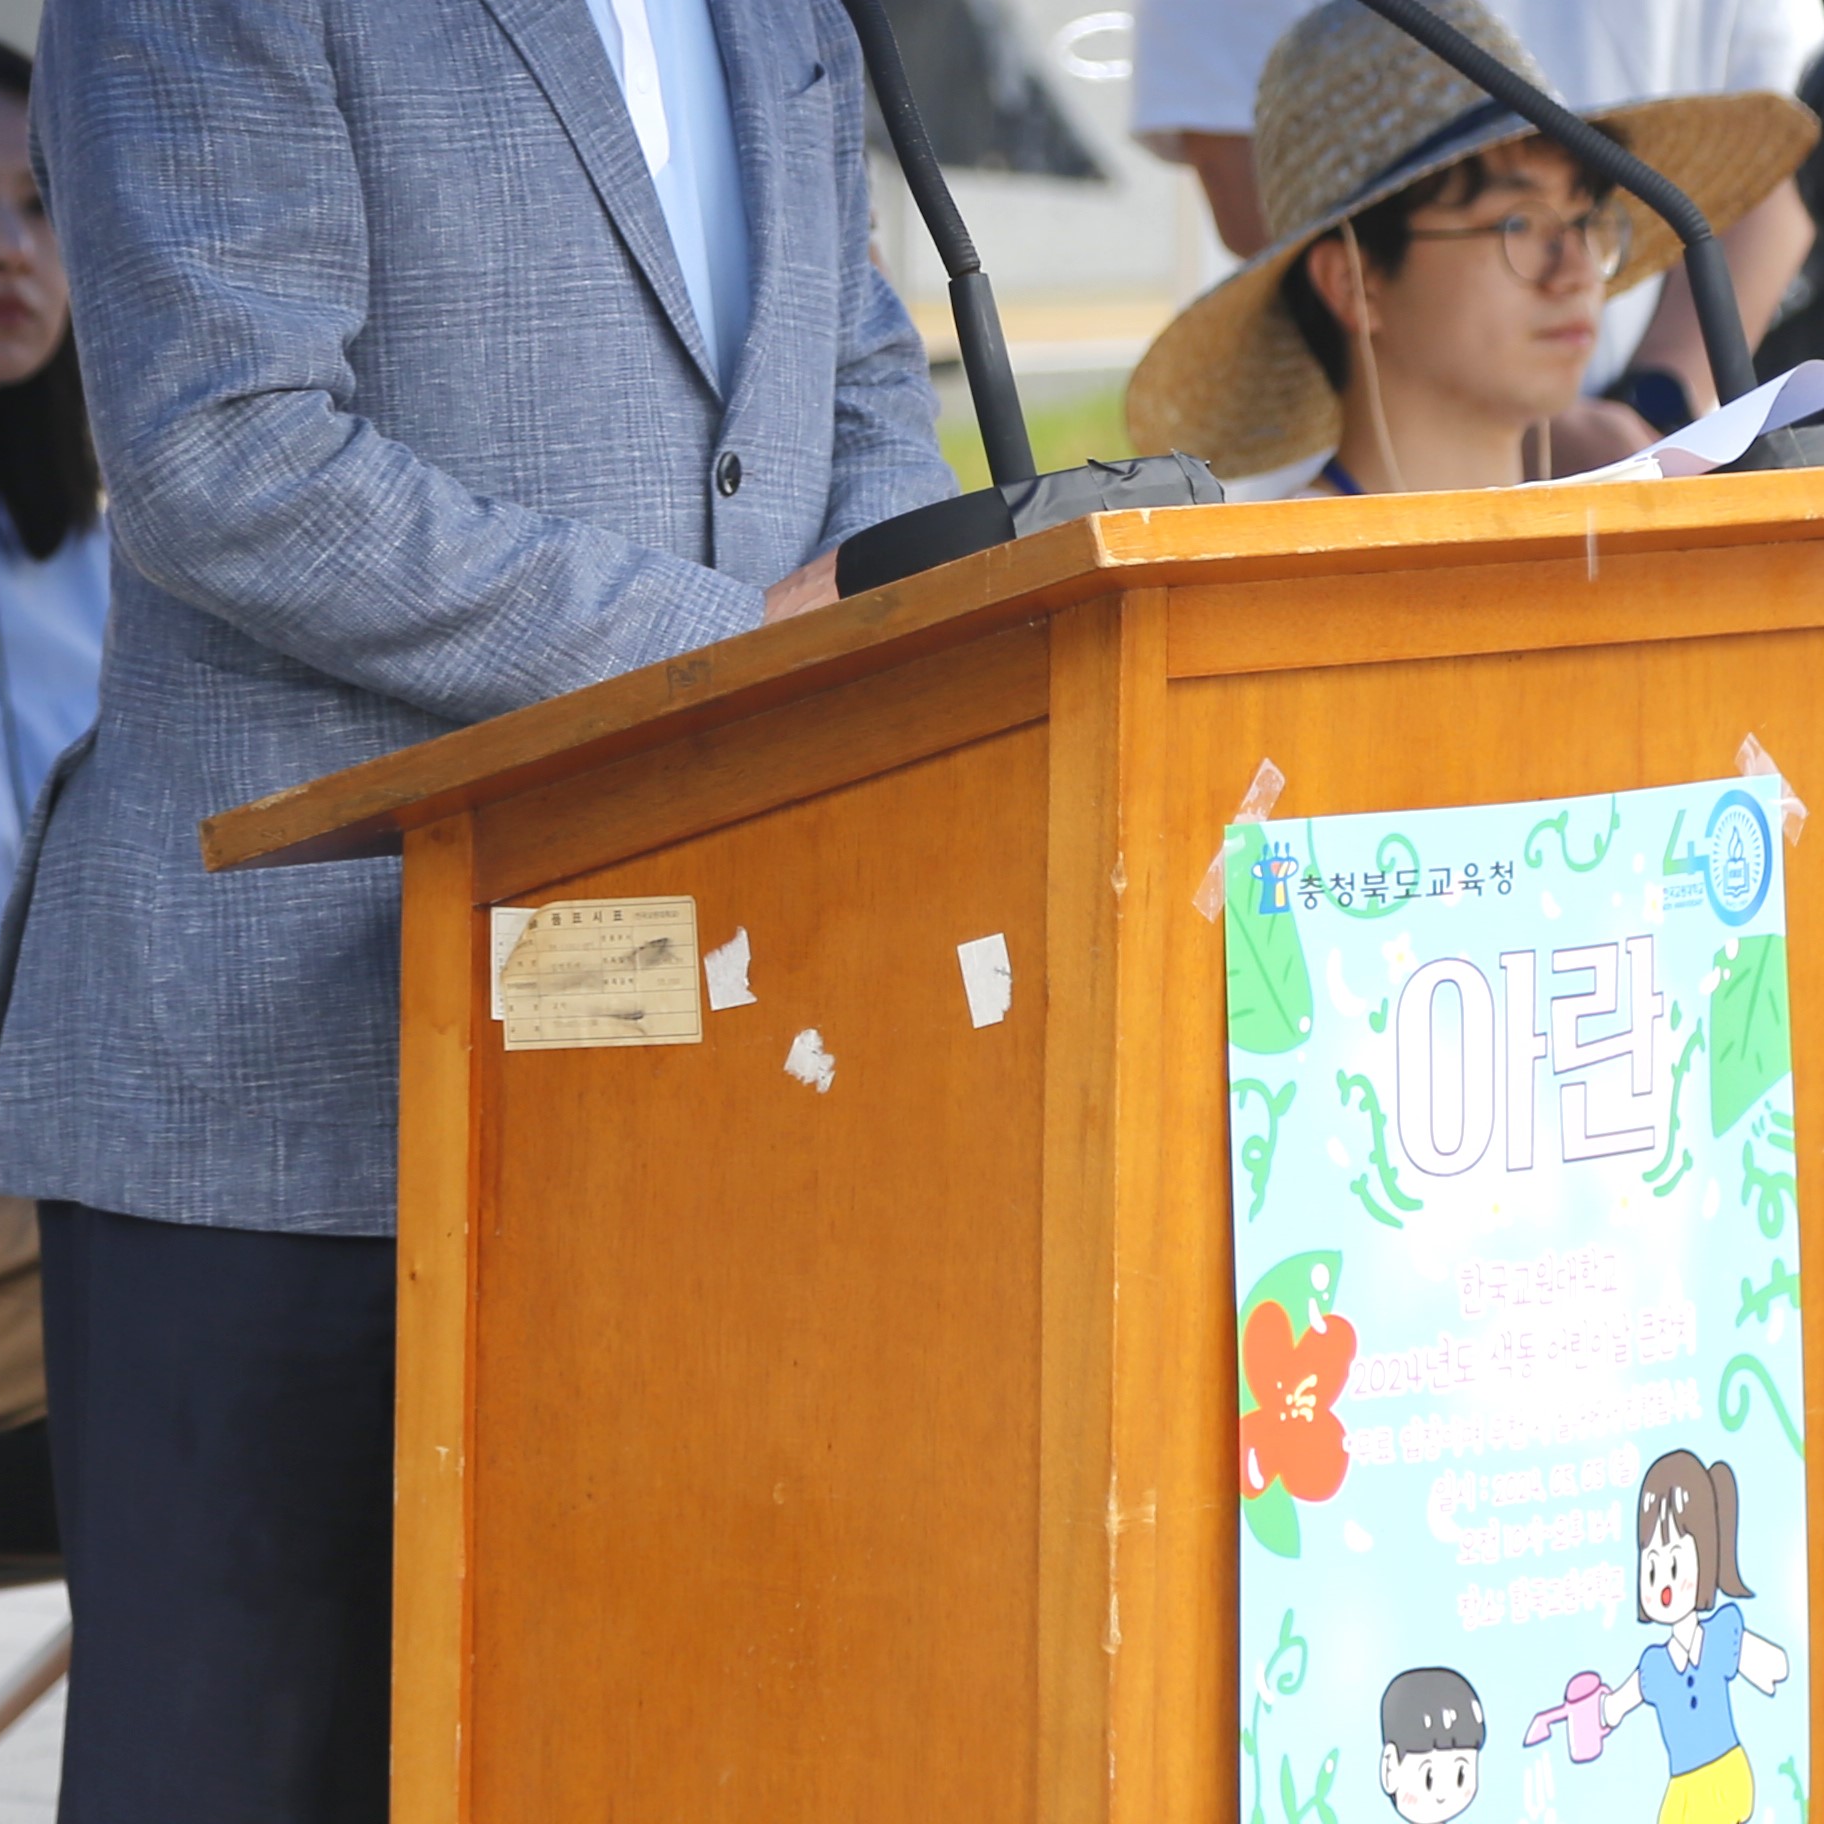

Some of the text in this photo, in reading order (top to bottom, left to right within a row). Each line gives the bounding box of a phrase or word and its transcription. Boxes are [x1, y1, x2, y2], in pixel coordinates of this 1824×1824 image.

[1297, 861, 1514, 910] 충청북도교육청
[1396, 934, 1664, 1177] 아란
[1460, 1248, 1618, 1315] 한국교원대학교
[1354, 1337, 1476, 1394] 2024년도
[1490, 1331, 1537, 1378] 색동
[1547, 1312, 1630, 1369] 어린이날
